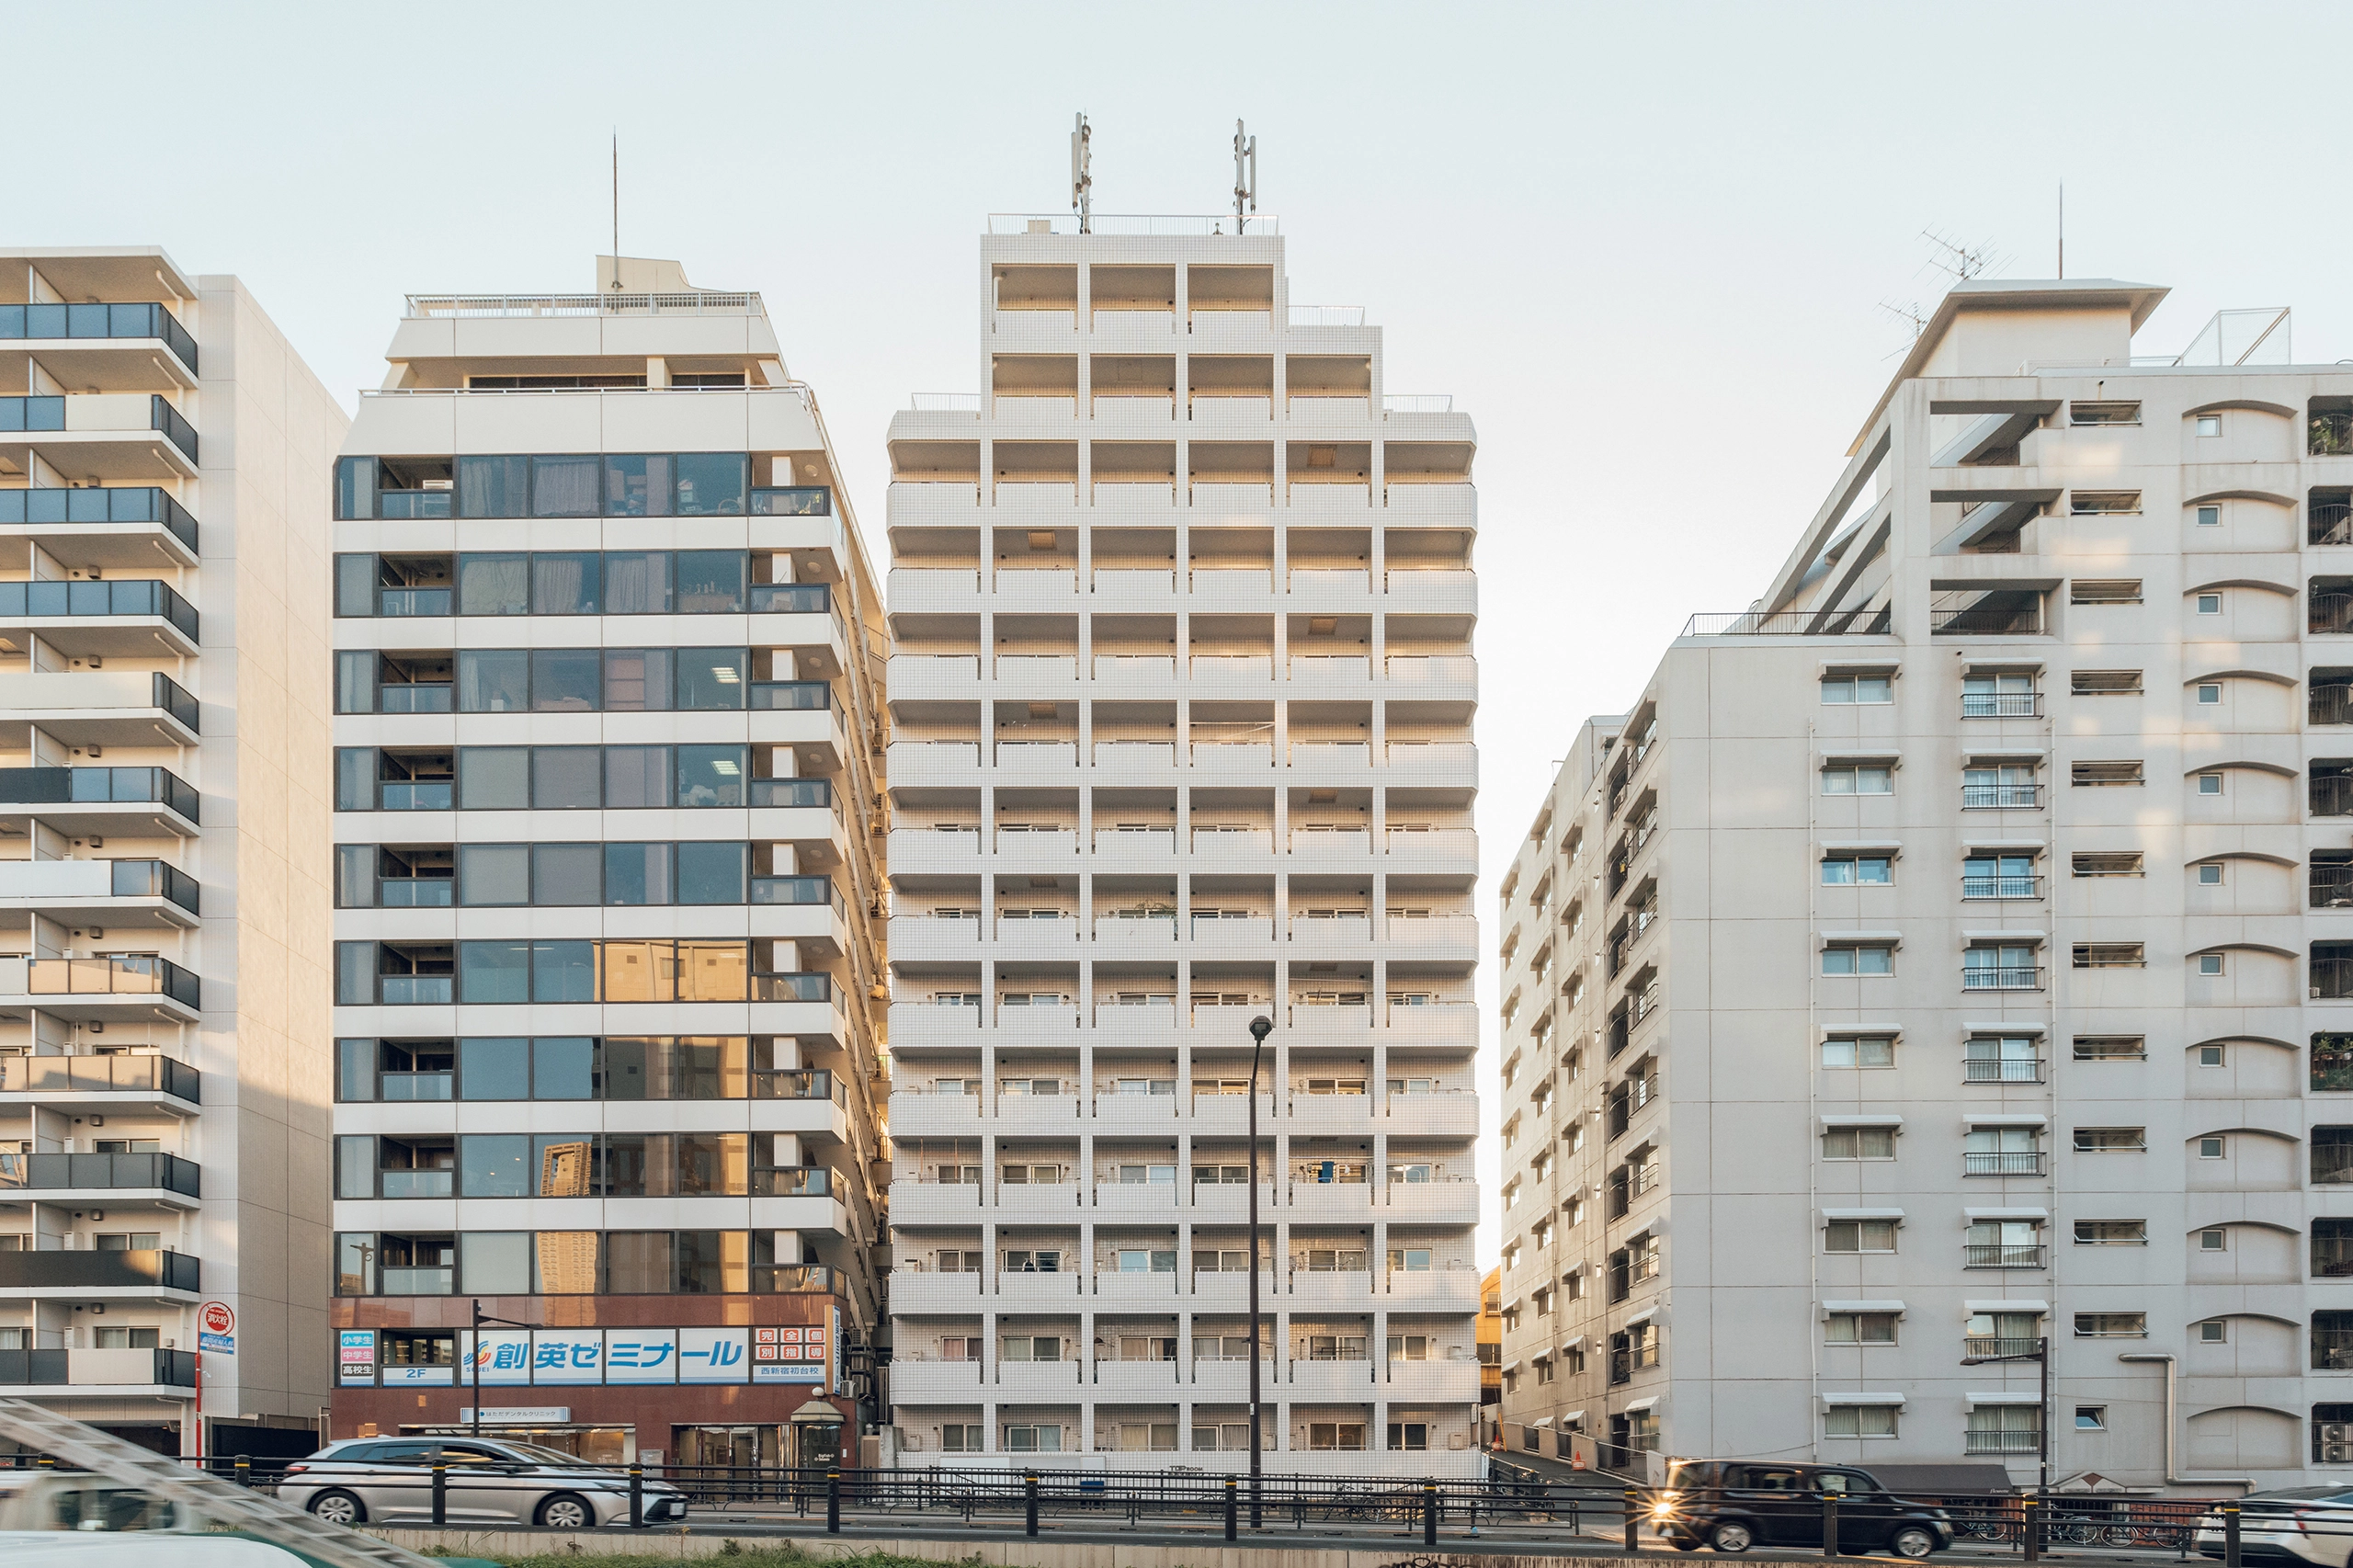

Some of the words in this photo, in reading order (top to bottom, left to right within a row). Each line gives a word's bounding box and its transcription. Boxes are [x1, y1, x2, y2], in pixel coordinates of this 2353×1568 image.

[207, 1312, 228, 1325] 消火栓
[343, 1336, 372, 1345] 小学生
[343, 1351, 372, 1359] 中学生
[493, 1341, 744, 1369] 創英ゼミナール
[343, 1366, 373, 1374] 高校生
[406, 1369, 426, 1378] 2F
[761, 1367, 819, 1375] 西新宿初台校
